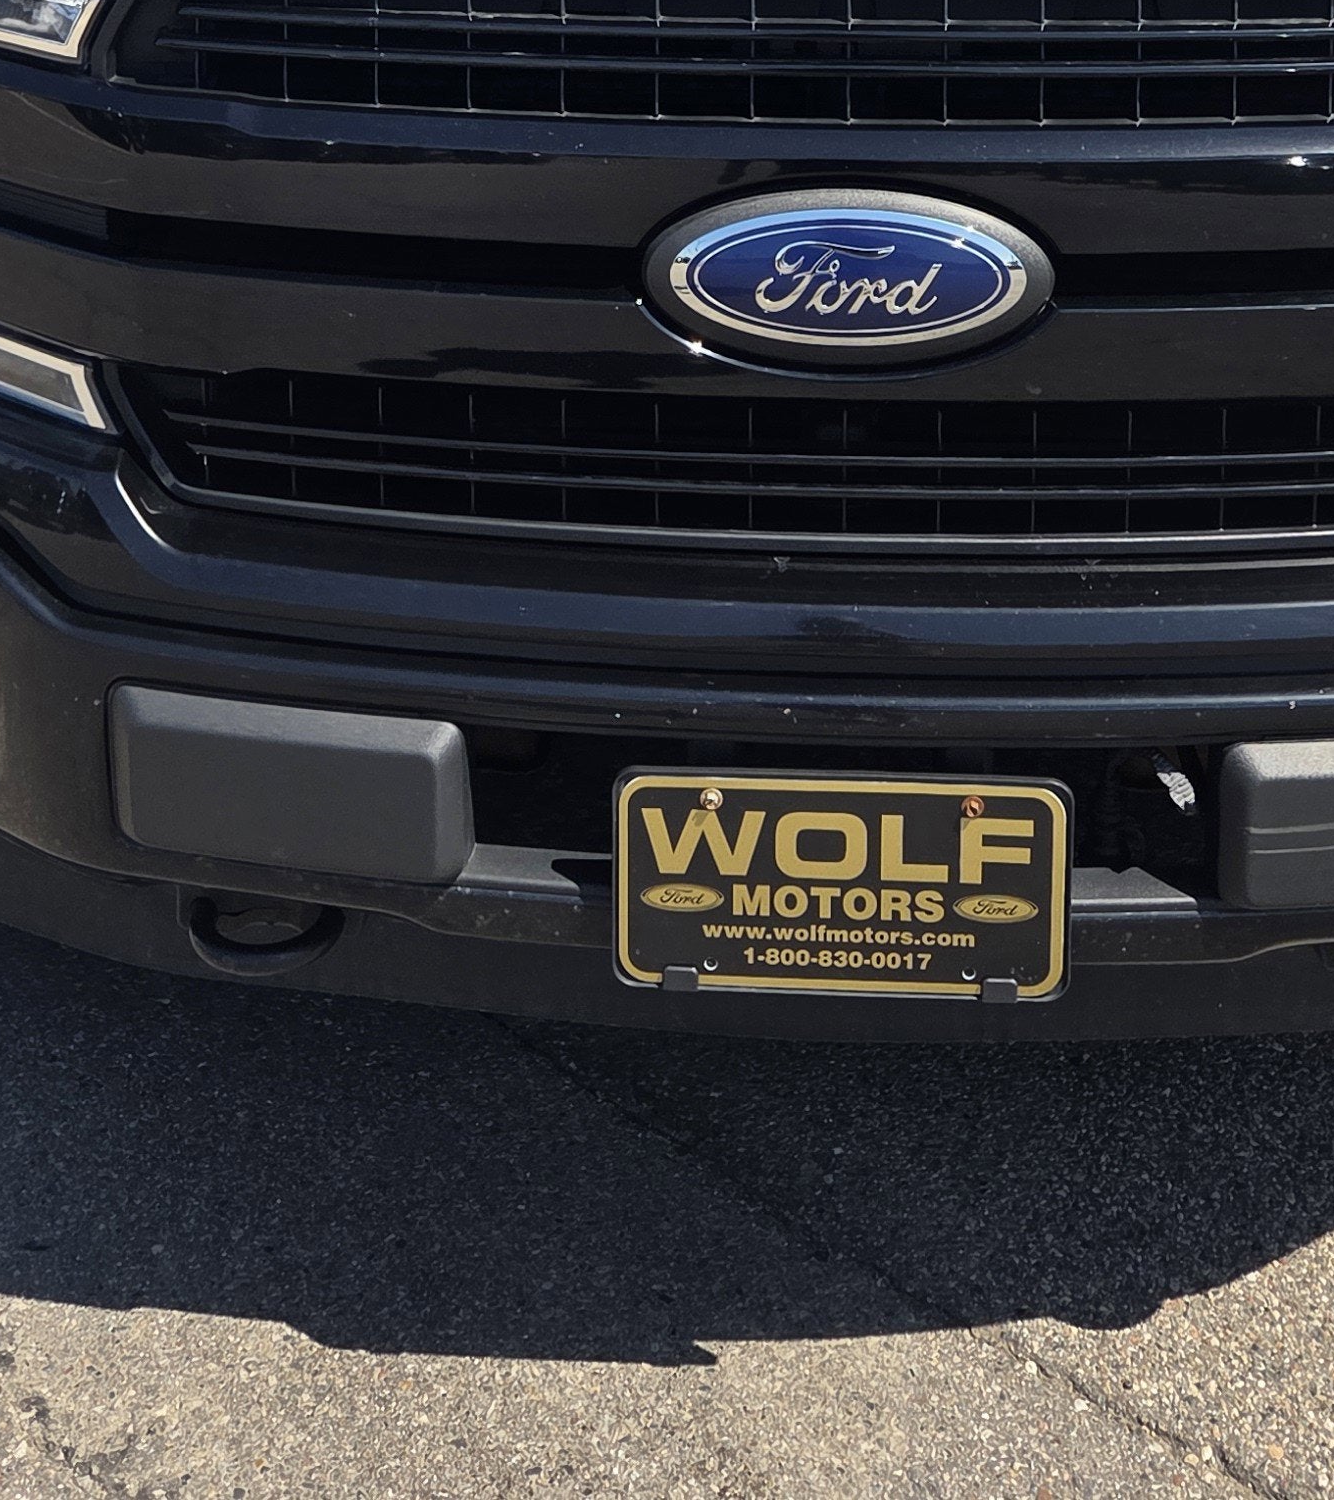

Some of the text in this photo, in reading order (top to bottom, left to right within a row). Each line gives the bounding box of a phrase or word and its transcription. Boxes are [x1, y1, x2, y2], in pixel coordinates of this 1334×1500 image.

[755, 240, 944, 316] Ford
[640, 807, 1035, 885] WOLF
[731, 883, 945, 923] MOTORS
[702, 923, 976, 948] www.wolfmotors.com
[743, 946, 933, 971] 1-800-830-0017
